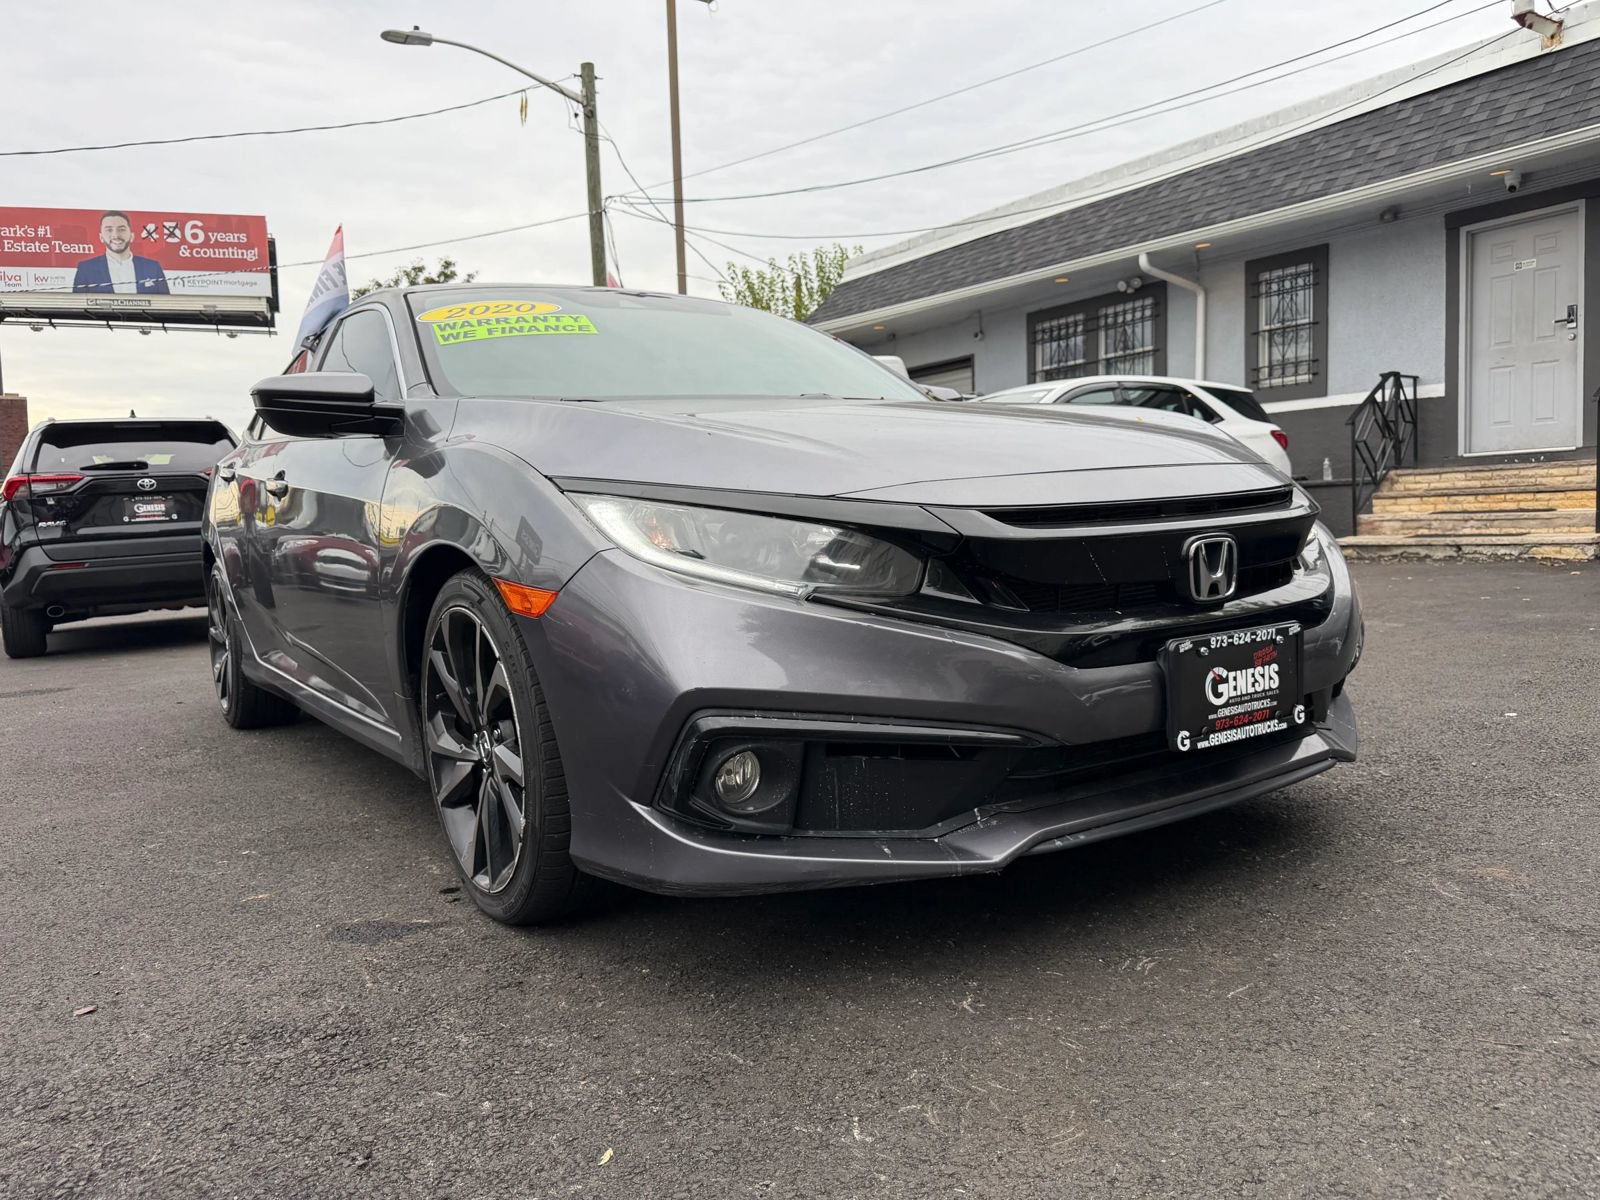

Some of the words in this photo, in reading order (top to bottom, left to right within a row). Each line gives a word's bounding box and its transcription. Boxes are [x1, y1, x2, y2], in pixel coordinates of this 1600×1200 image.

[0, 225, 35, 237] ark's
[37, 226, 52, 238] #1
[184, 220, 205, 244] 6
[208, 232, 248, 244] years
[3, 240, 50, 252] Estate
[52, 241, 94, 254] Team
[179, 245, 191, 257] &
[192, 247, 259, 262] counting!
[34, 273, 49, 282] kw
[445, 303, 537, 319] 2020
[437, 314, 585, 332] WARRANTY
[440, 329, 476, 342] WE
[486, 324, 592, 336] FINANCE
[1210, 629, 1276, 648] 973-624-2071
[1205, 663, 1280, 706] GENESIS
[1215, 709, 1270, 730] 973-624-2071
